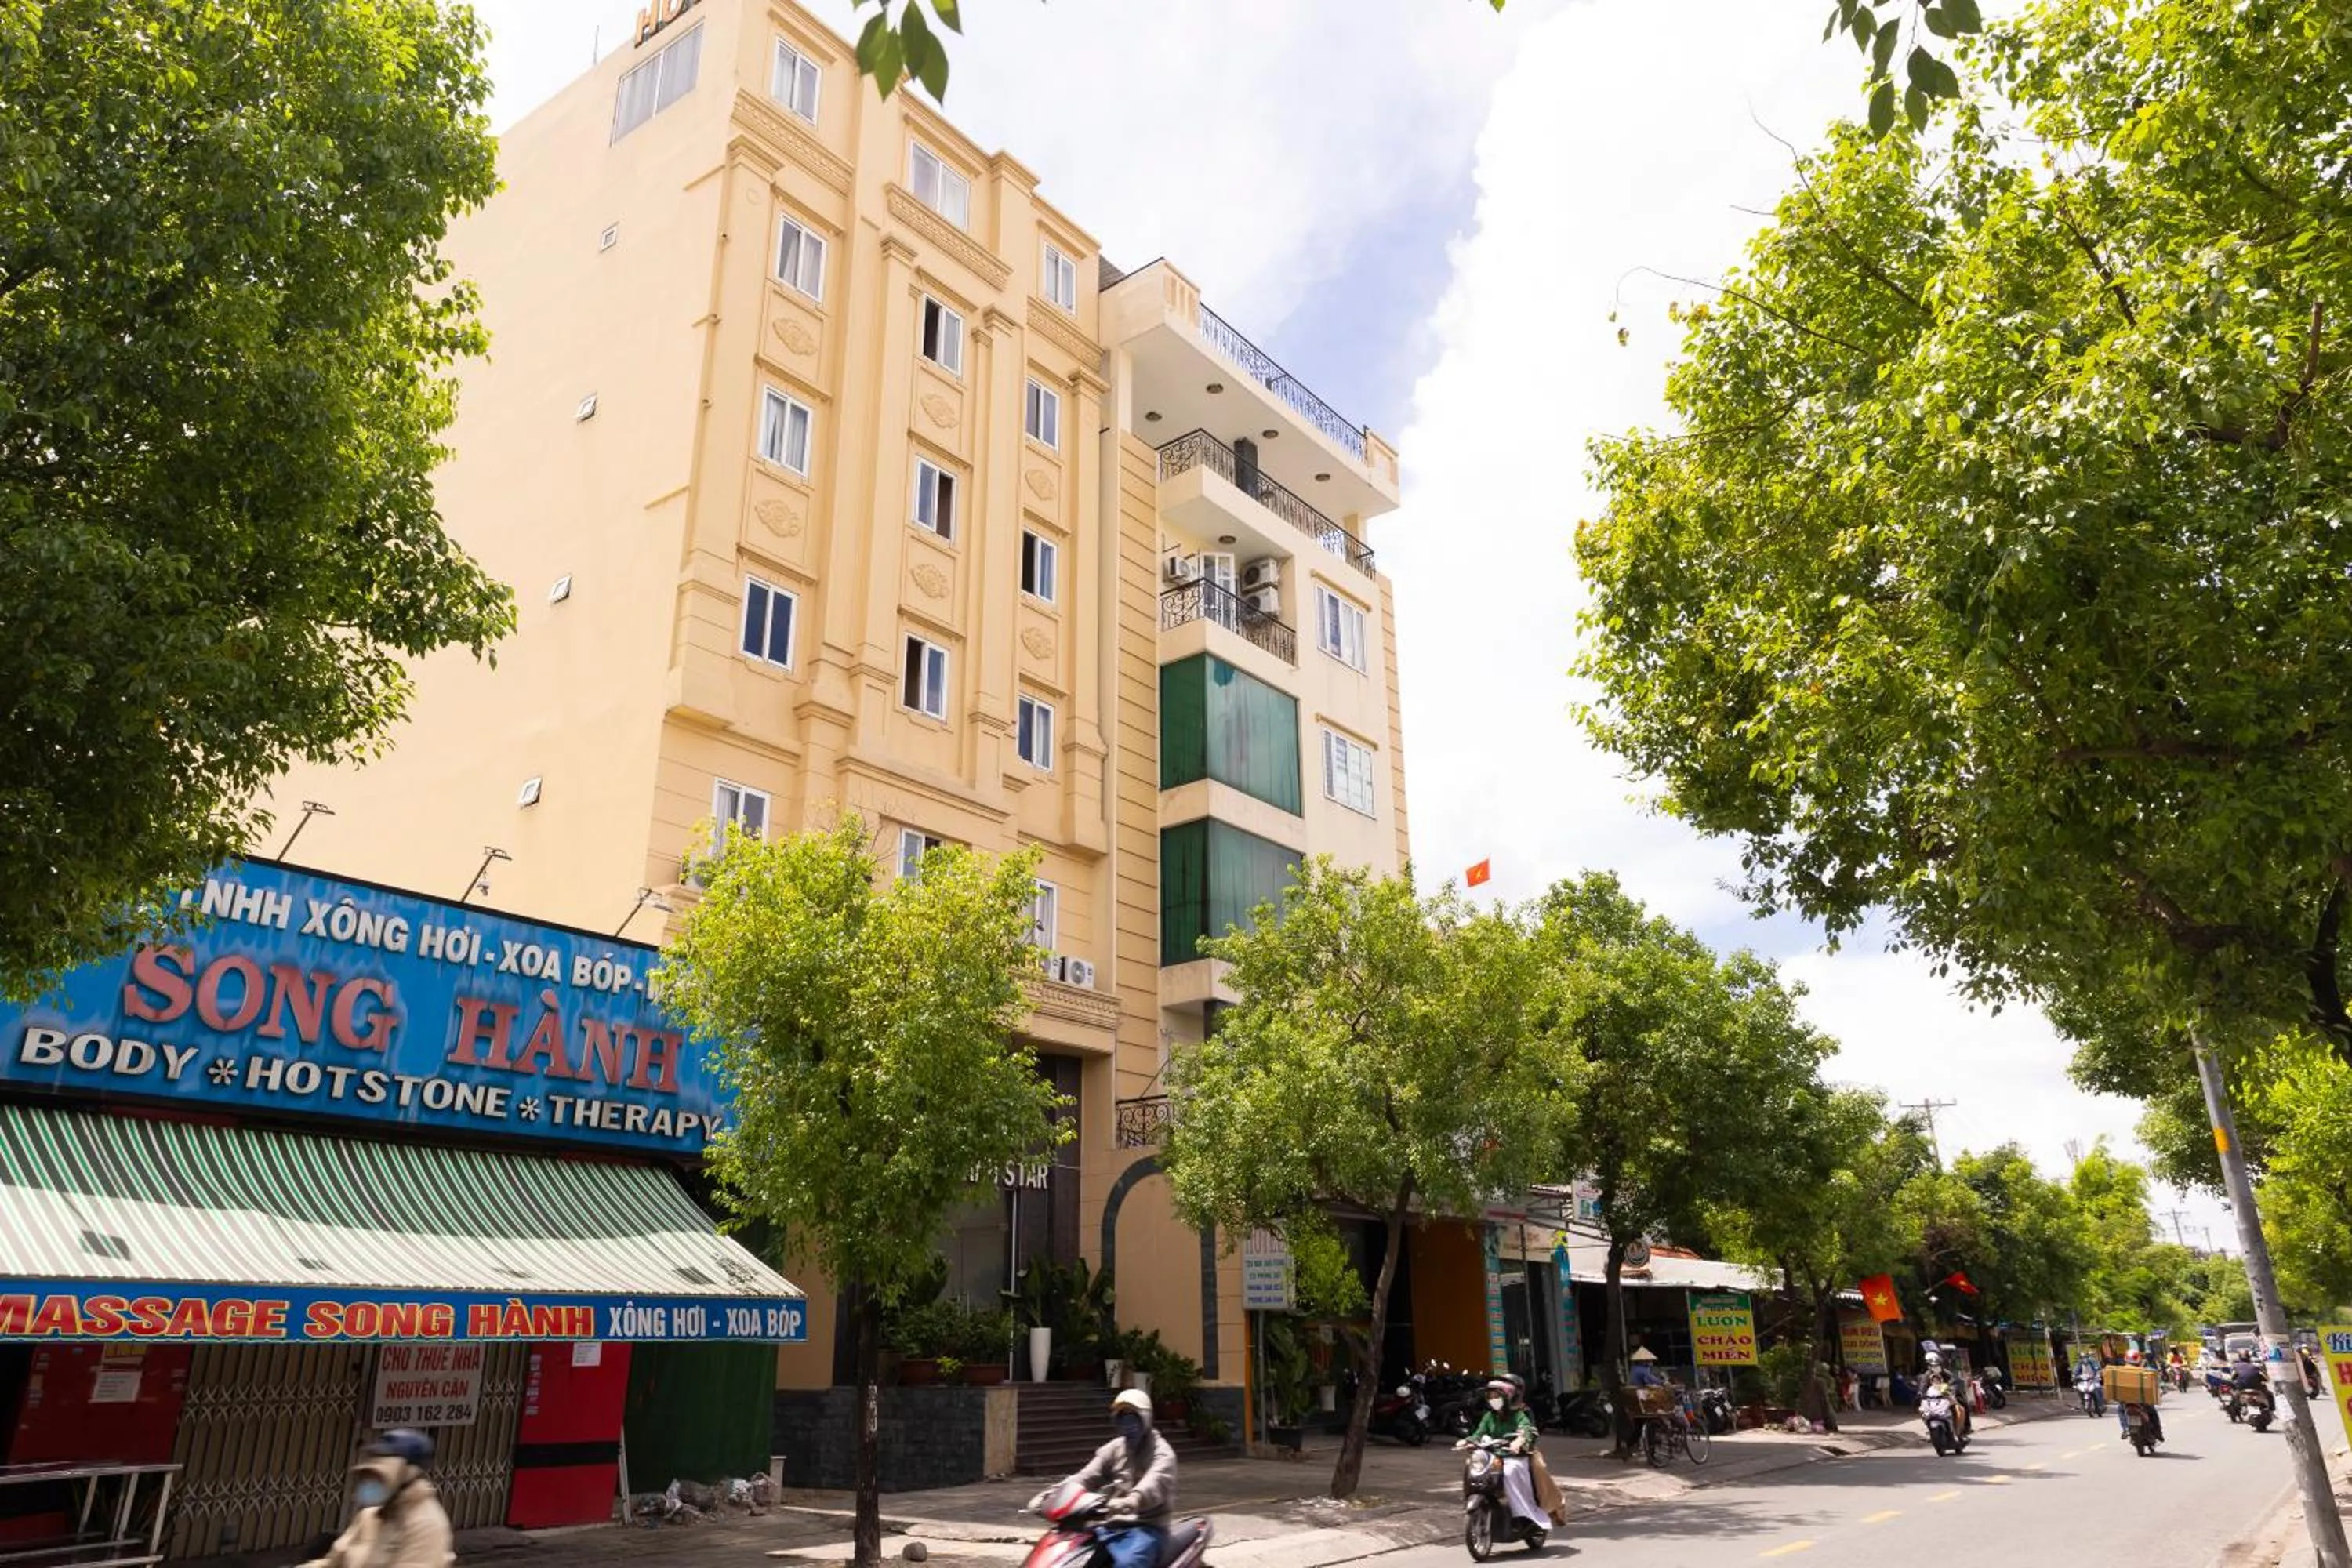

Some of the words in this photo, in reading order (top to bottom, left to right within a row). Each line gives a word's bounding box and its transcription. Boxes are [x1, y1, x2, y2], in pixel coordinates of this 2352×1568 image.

[301, 898, 408, 953] XÔNG
[419, 925, 481, 966] HƠI
[499, 940, 561, 982] XOA
[572, 953, 632, 993] BÓP
[124, 943, 397, 1052] SONG
[448, 989, 684, 1093] HÀNH
[20, 1027, 199, 1080] BODY
[550, 1096, 722, 1141] THERAPY
[304, 1301, 455, 1338] SONG
[467, 1298, 595, 1338] HÀNH
[608, 1301, 666, 1337] XÔNG
[672, 1305, 706, 1337] HƠI
[726, 1308, 762, 1337] XOA
[767, 1305, 801, 1337] BÓP
[383, 1346, 412, 1371] CHO
[416, 1405, 442, 1421] 162
